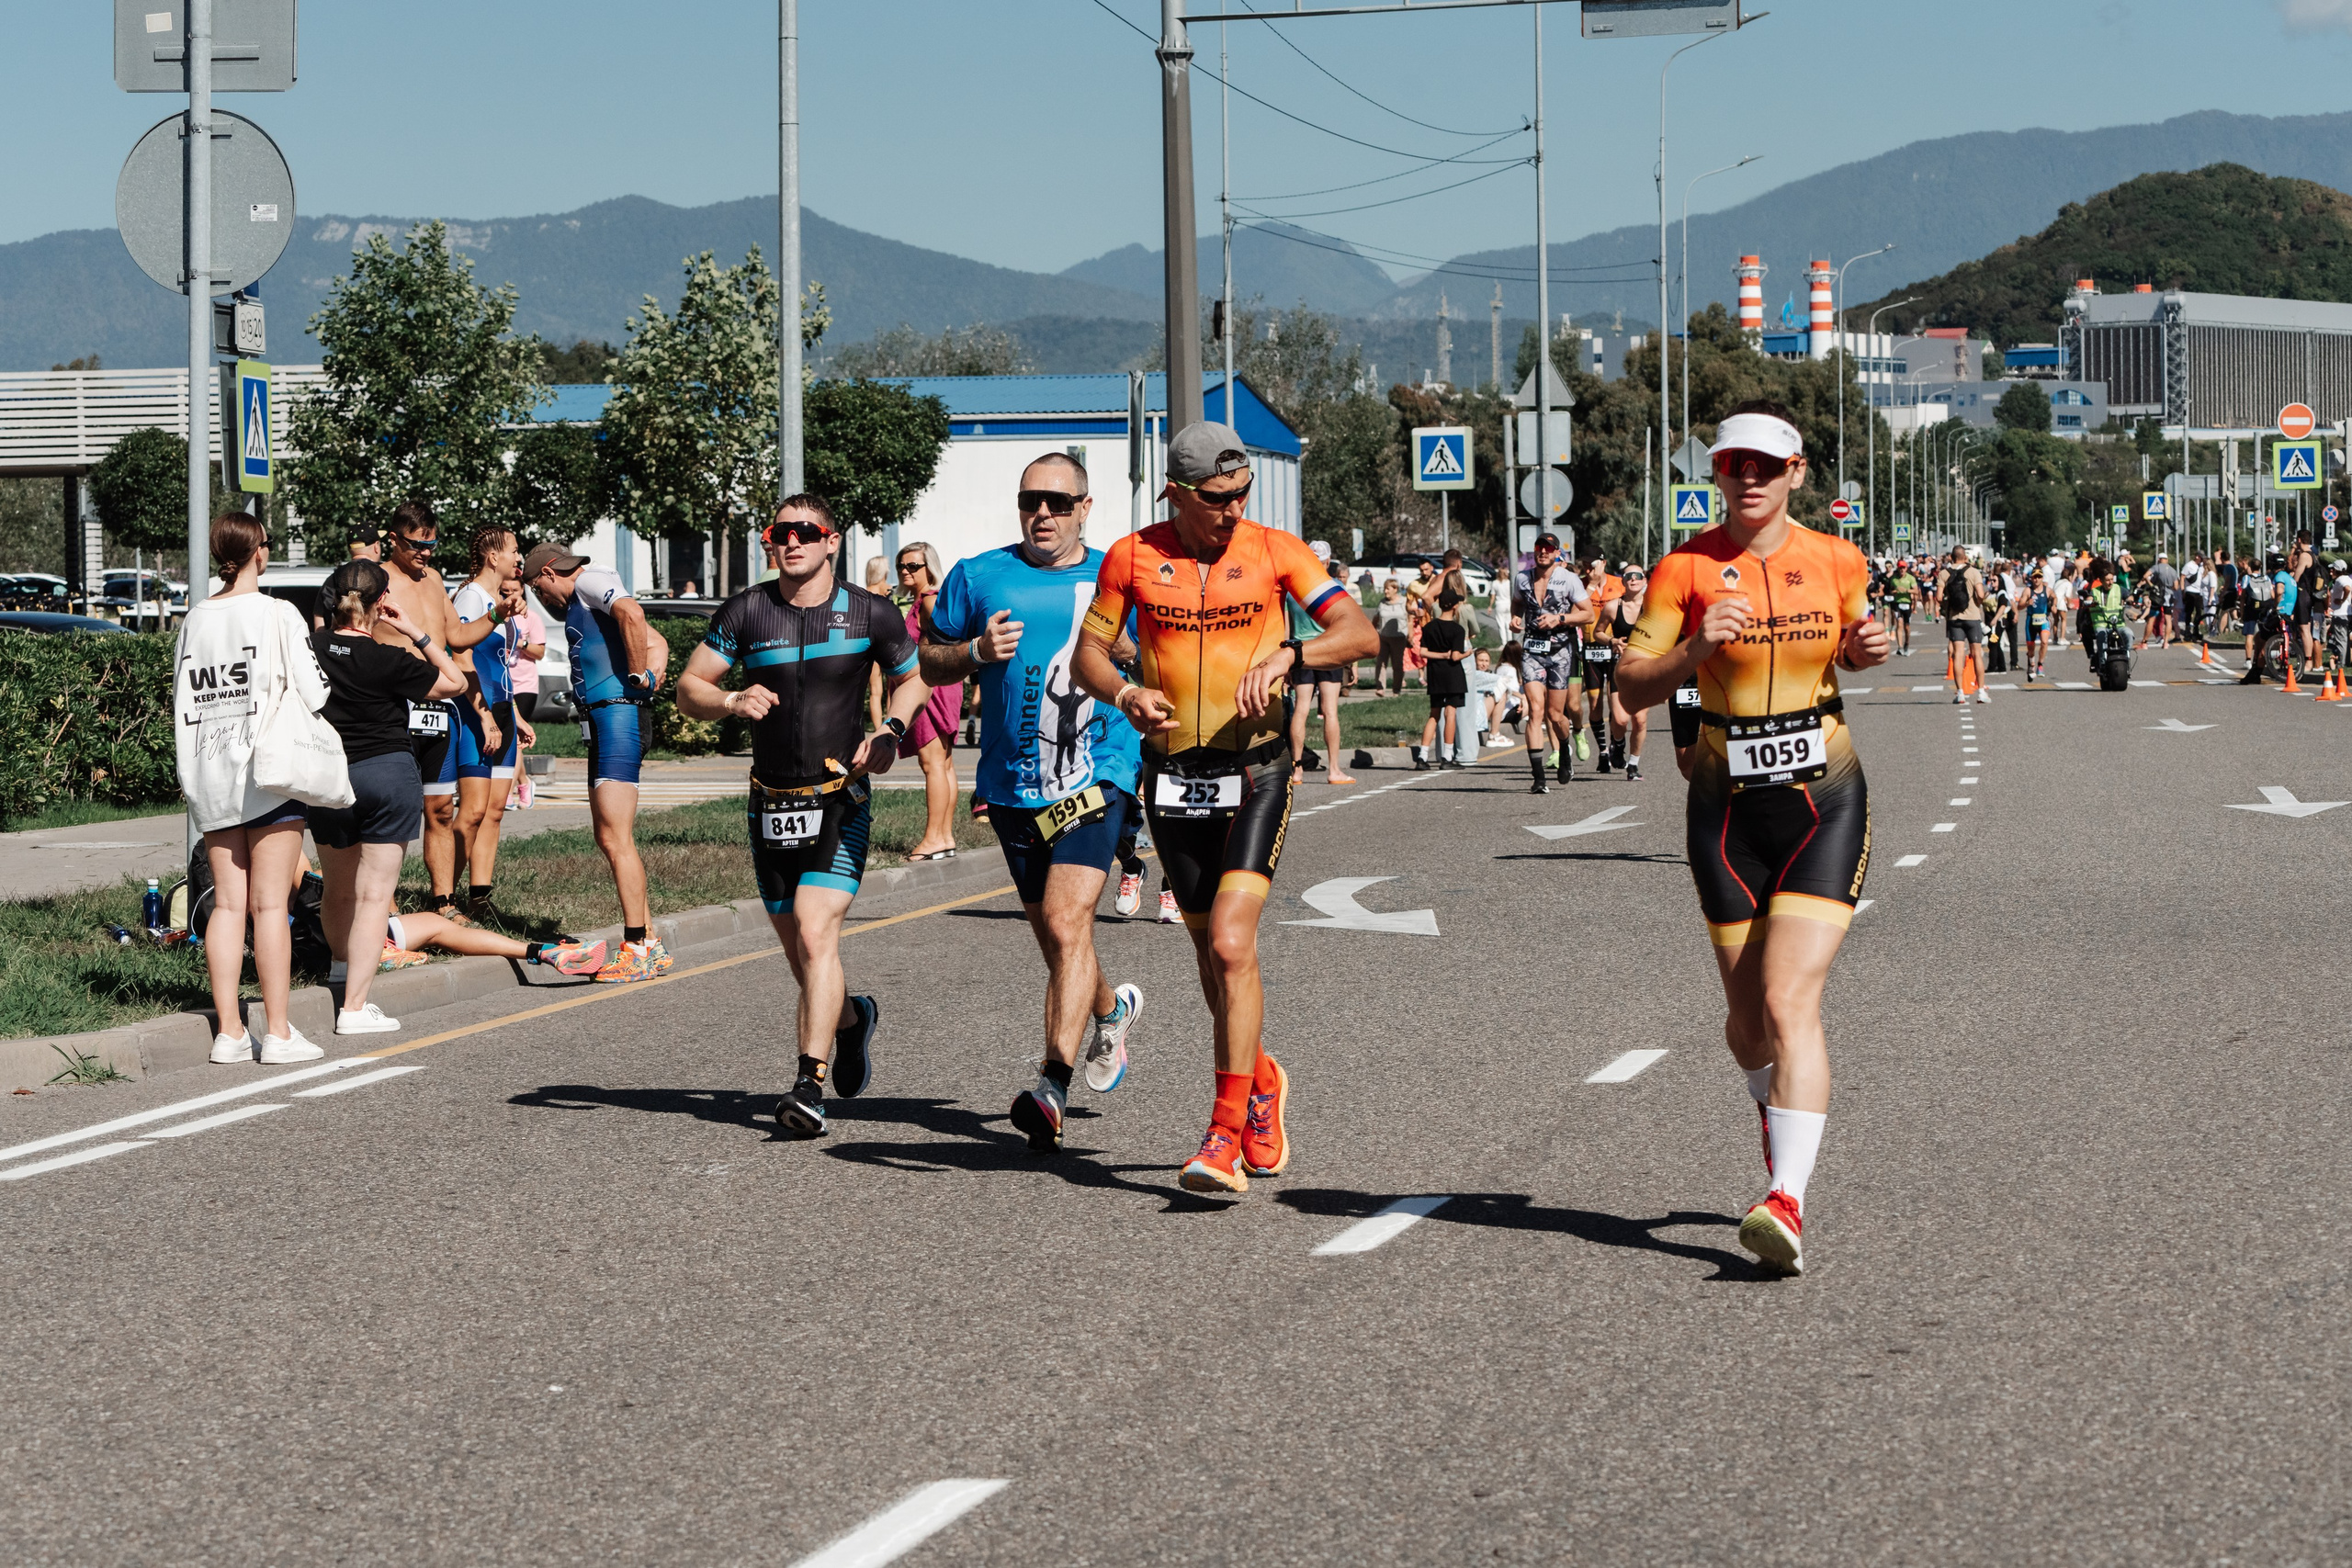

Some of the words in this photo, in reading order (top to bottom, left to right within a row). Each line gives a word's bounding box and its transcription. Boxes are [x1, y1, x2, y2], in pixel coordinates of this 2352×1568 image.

[246, 319, 253, 335] 15
[254, 317, 263, 338] 20
[1144, 601, 1263, 621] РОСНЕФТЬ
[1155, 617, 1252, 633] ТРИАТЛОН
[749, 637, 790, 650] stimulate
[1527, 640, 1545, 649] 1089
[1590, 650, 1605, 659] 996
[188, 661, 249, 692] WKS
[193, 693, 217, 705] KEEP
[218, 687, 249, 700] WARM
[195, 702, 220, 712] EXPLORING
[232, 697, 250, 705] WORLD
[421, 714, 439, 728] 471
[1744, 738, 1810, 770] 1059
[1769, 772, 1794, 783] ЗАИРА
[1179, 782, 1220, 804] 252
[1047, 791, 1090, 828] 1591
[1185, 807, 1211, 817] АНДРЕЙ
[771, 815, 807, 837] 841
[1063, 818, 1080, 832] СЕРГЕЙ
[782, 839, 799, 847] АРТЕМ
